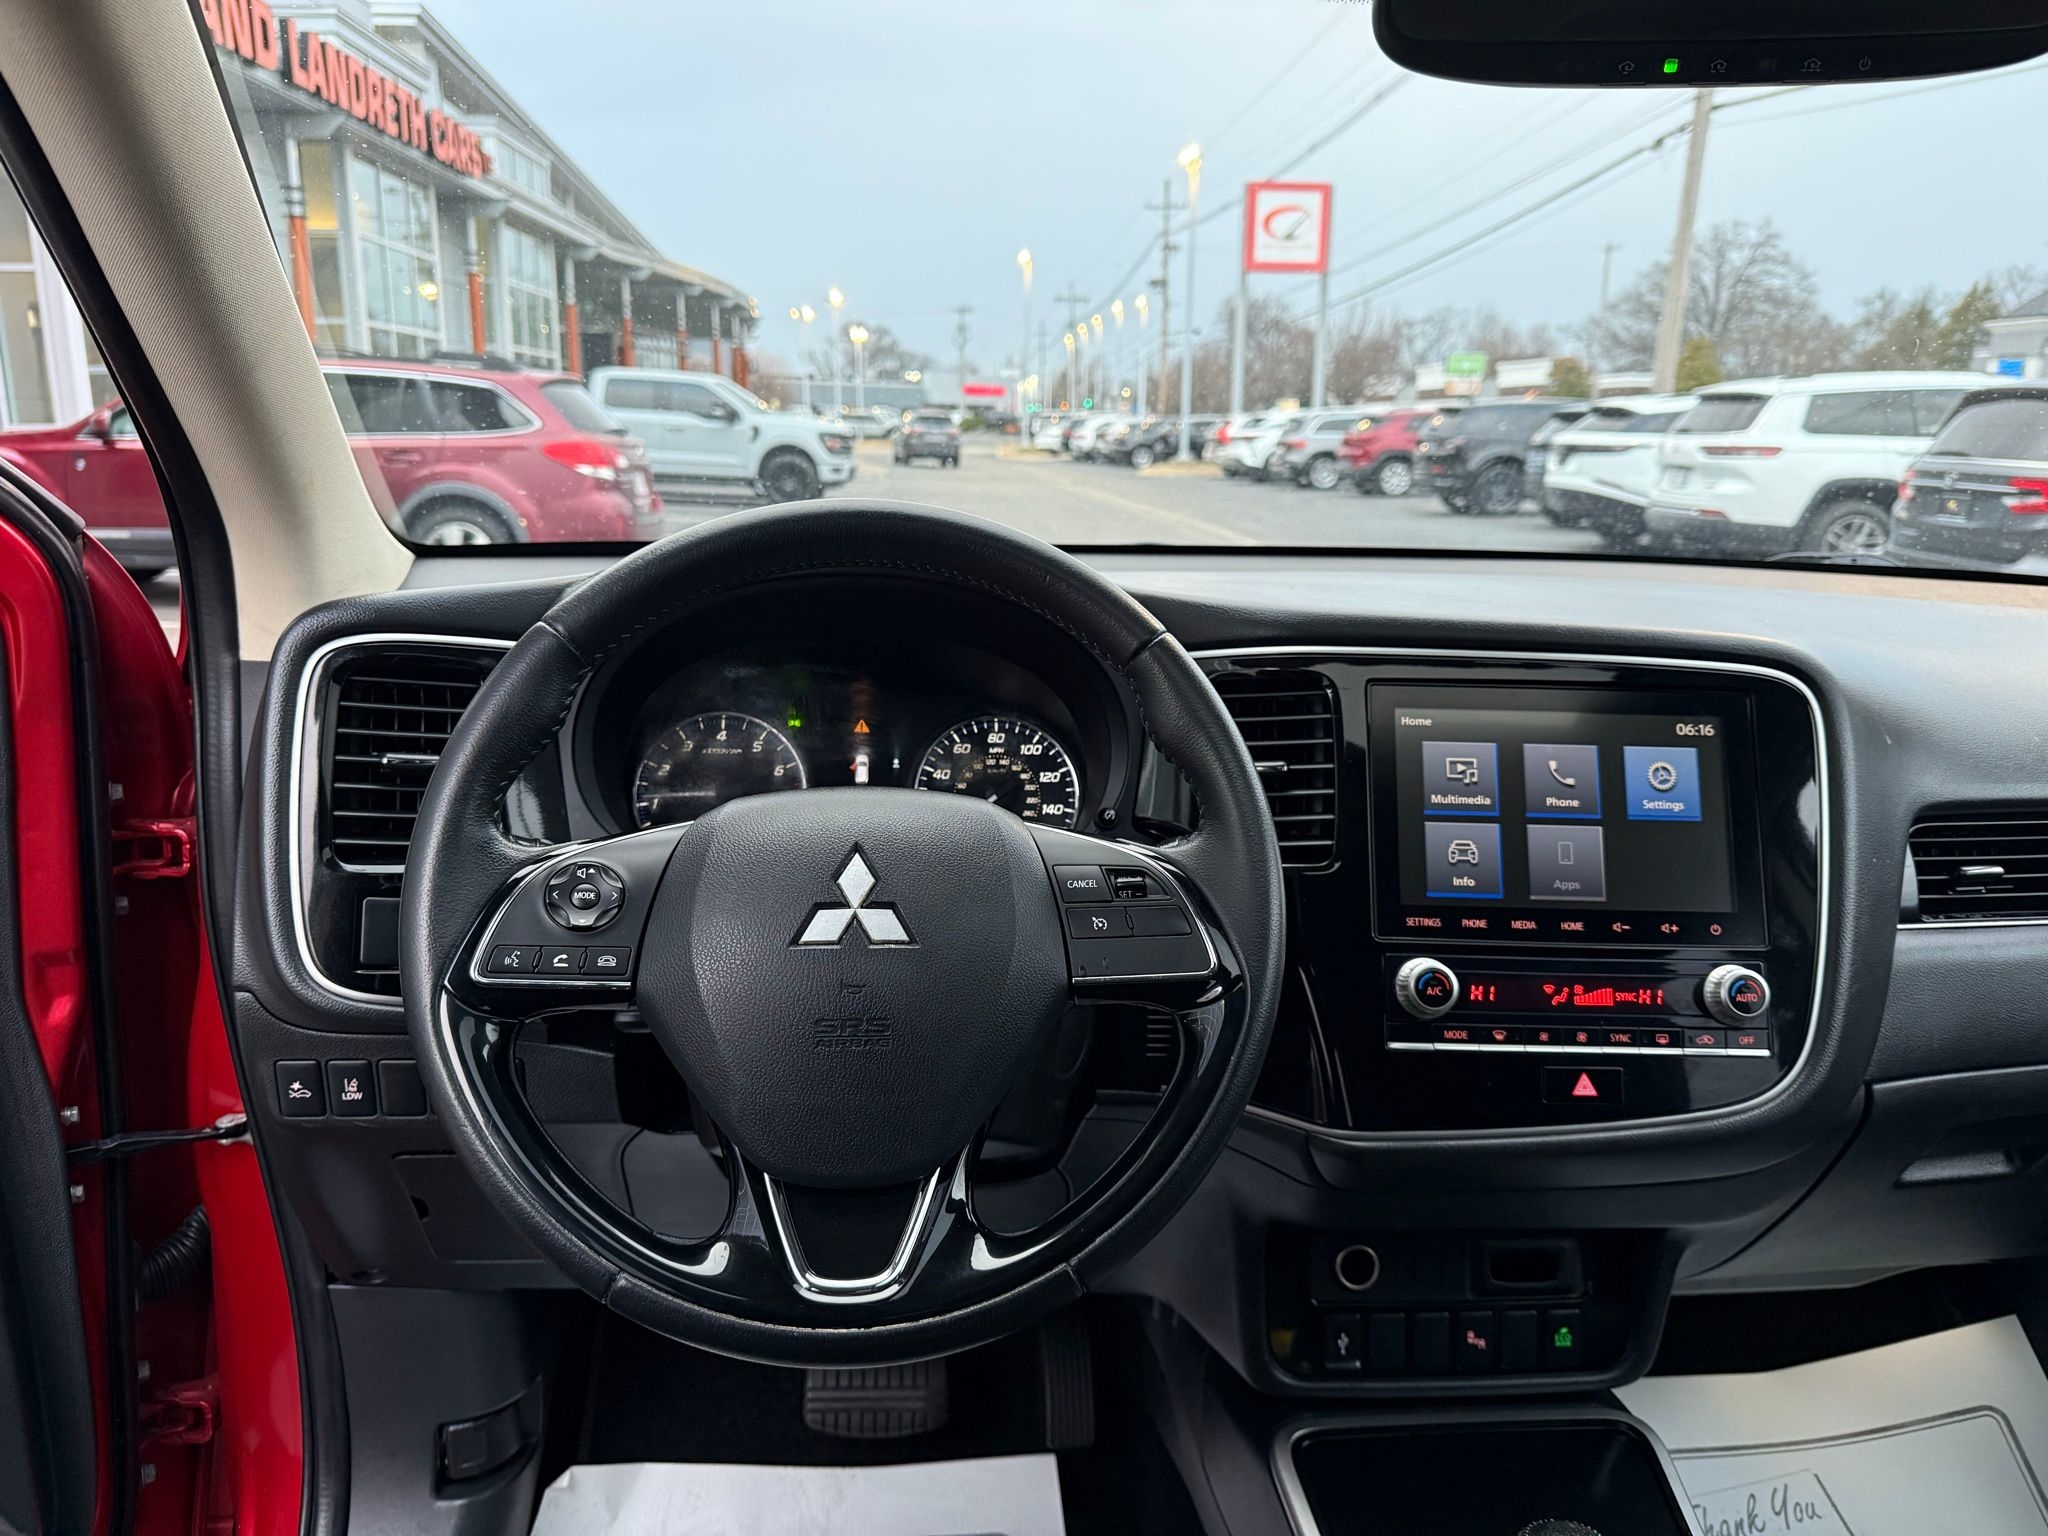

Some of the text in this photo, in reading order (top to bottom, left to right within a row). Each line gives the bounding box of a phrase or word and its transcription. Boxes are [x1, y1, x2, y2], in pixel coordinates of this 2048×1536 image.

[286, 17, 430, 152] LANDRETH
[431, 108, 483, 179] CARS
[1400, 716, 1433, 727] Home
[1675, 722, 1716, 737] 06:16
[716, 730, 728, 742] 4
[987, 733, 1006, 744] 80
[683, 741, 694, 752] 3
[752, 741, 764, 752] 5
[953, 744, 971, 755] 60
[1020, 744, 1043, 755] 100
[658, 764, 670, 776] 2
[774, 765, 785, 776] 6
[932, 769, 951, 780] 40
[1039, 772, 1061, 783] 120
[1431, 794, 1491, 805] Multimedia
[1546, 797, 1580, 808] Phone
[1041, 804, 1064, 815] 140
[1642, 800, 1685, 812] Settings
[1067, 880, 1098, 888] CANCEL
[1453, 876, 1475, 886] Info
[1554, 880, 1581, 891] Apps
[574, 892, 596, 900] MODE
[1118, 890, 1132, 899] SET
[1406, 917, 1442, 927] SETTINGS
[1462, 919, 1488, 928] PHONE
[1511, 921, 1537, 930] MEDIA
[1561, 922, 1585, 931] HOME
[1426, 986, 1443, 996] A/C
[1615, 992, 1637, 1001] SYNC
[1736, 993, 1758, 1002] AUTO
[814, 1018, 893, 1036] SRS
[1444, 1030, 1468, 1040] MODE
[1610, 1033, 1631, 1043] SYNC
[1739, 1036, 1755, 1045] OFF
[815, 1039, 893, 1051] AIRBAG
[342, 1092, 363, 1101] LDW
[1771, 1483, 1823, 1530] You
